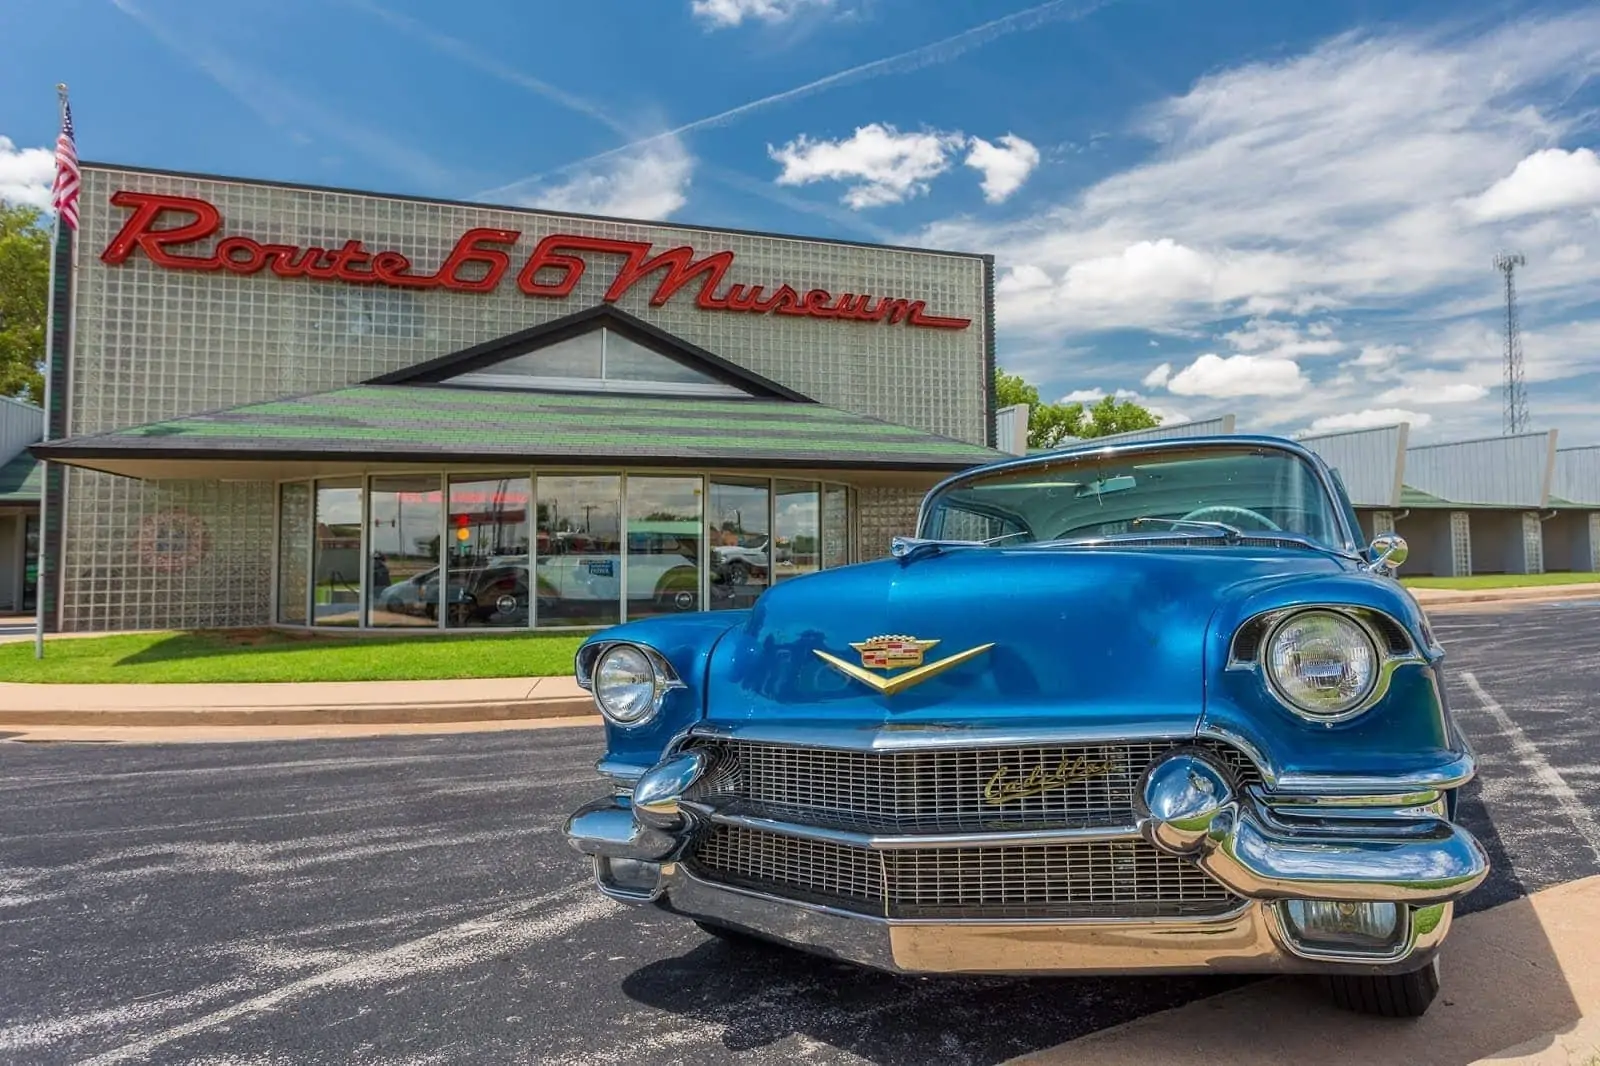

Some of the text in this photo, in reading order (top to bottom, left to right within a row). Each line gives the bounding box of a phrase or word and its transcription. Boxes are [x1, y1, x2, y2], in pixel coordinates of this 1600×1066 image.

[101, 190, 971, 329] Route 66 Museum
[984, 756, 1116, 803] Cadillac
